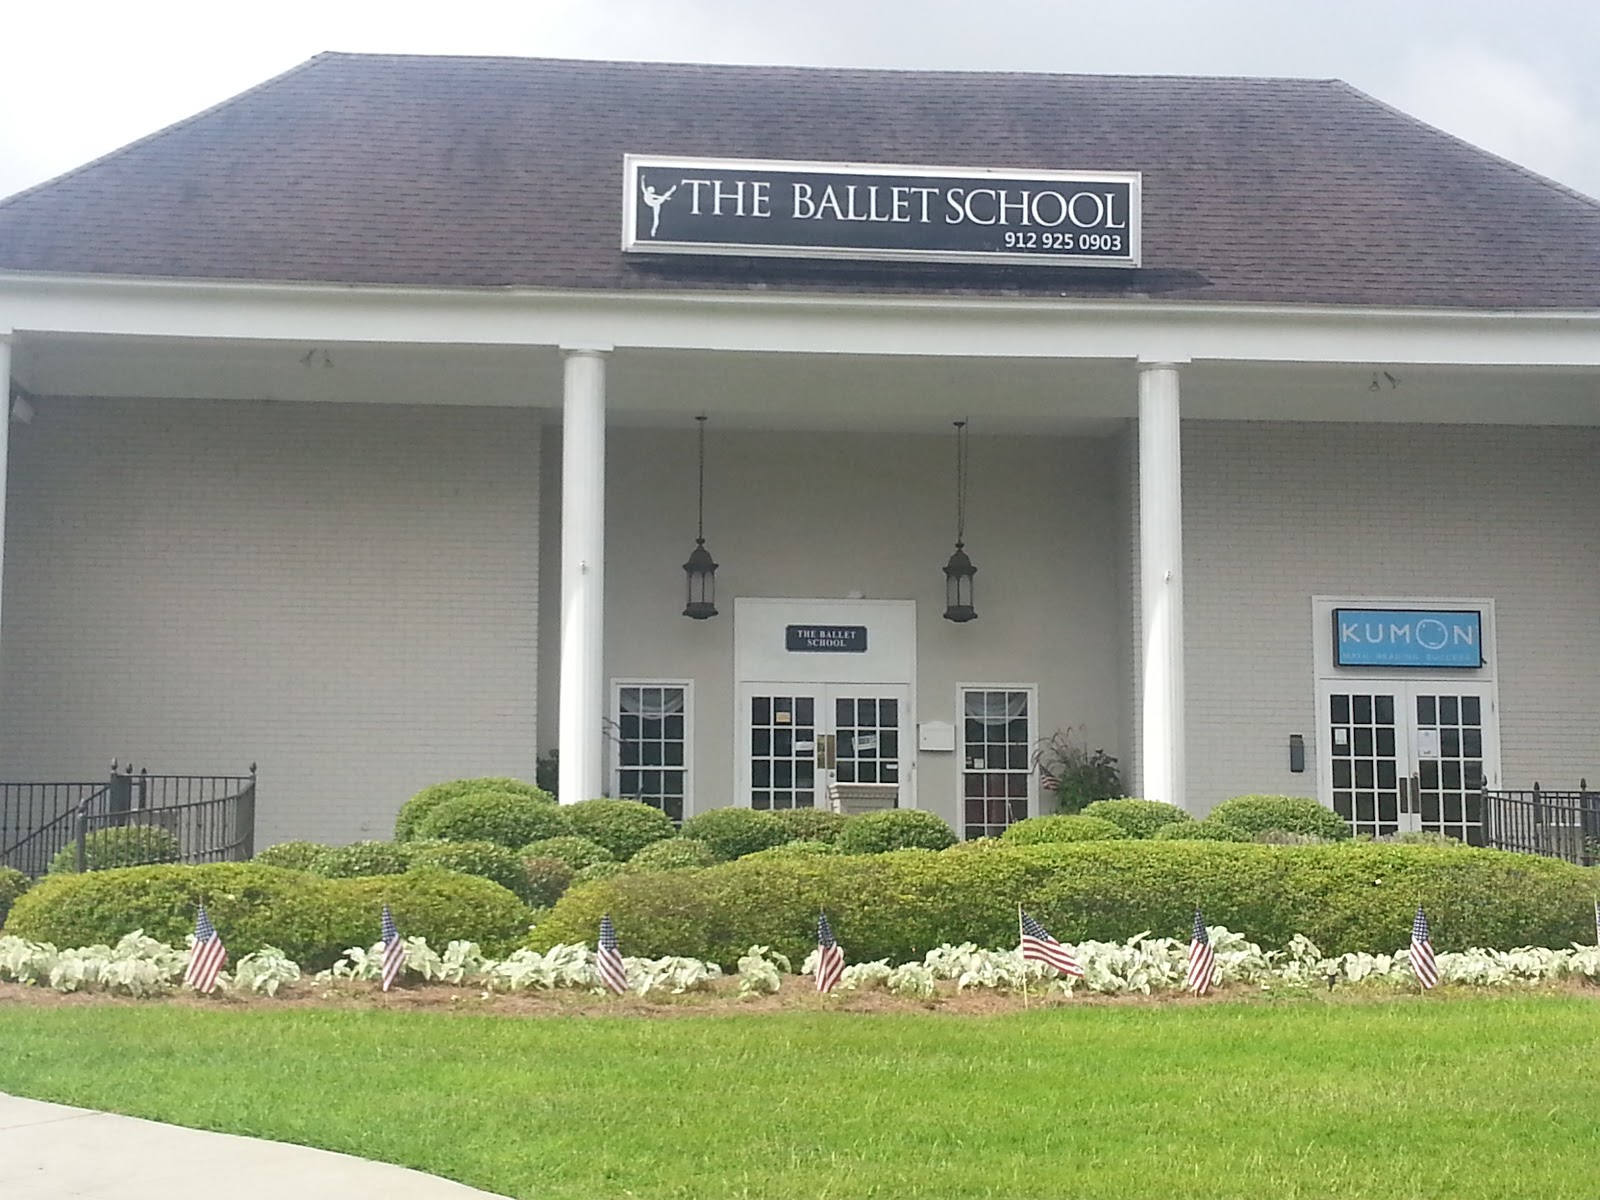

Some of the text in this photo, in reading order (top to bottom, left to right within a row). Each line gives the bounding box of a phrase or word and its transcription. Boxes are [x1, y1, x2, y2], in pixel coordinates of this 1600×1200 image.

[681, 179, 1126, 229] THE BALLET SCHOOL
[1005, 231, 1122, 250] 912 925 0903
[798, 630, 856, 647] THE BALLET SCHOOL
[1342, 619, 1472, 650] KUMON
